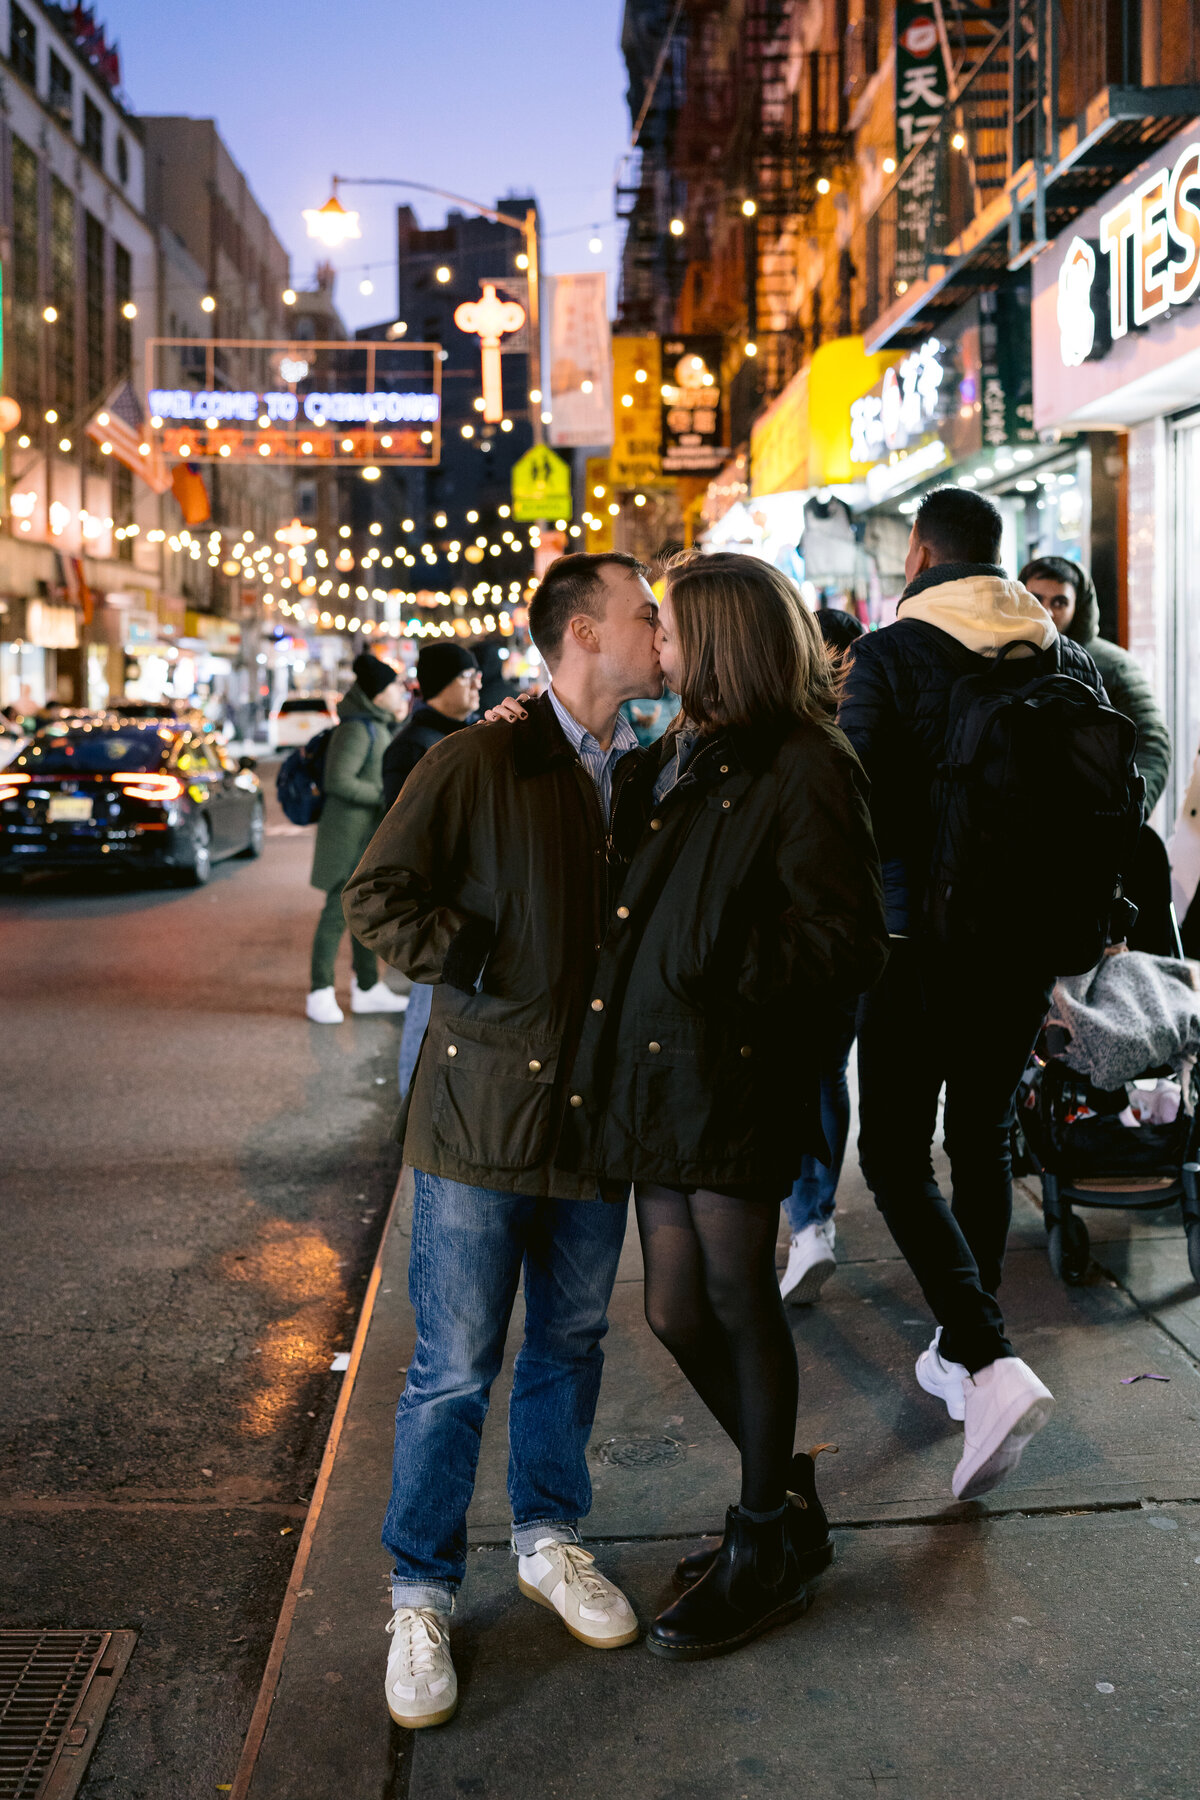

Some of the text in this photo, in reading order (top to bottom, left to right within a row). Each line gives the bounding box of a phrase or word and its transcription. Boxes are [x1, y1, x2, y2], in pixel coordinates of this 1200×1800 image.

[148, 389, 440, 422] WELCOME TO CHINATOWN
